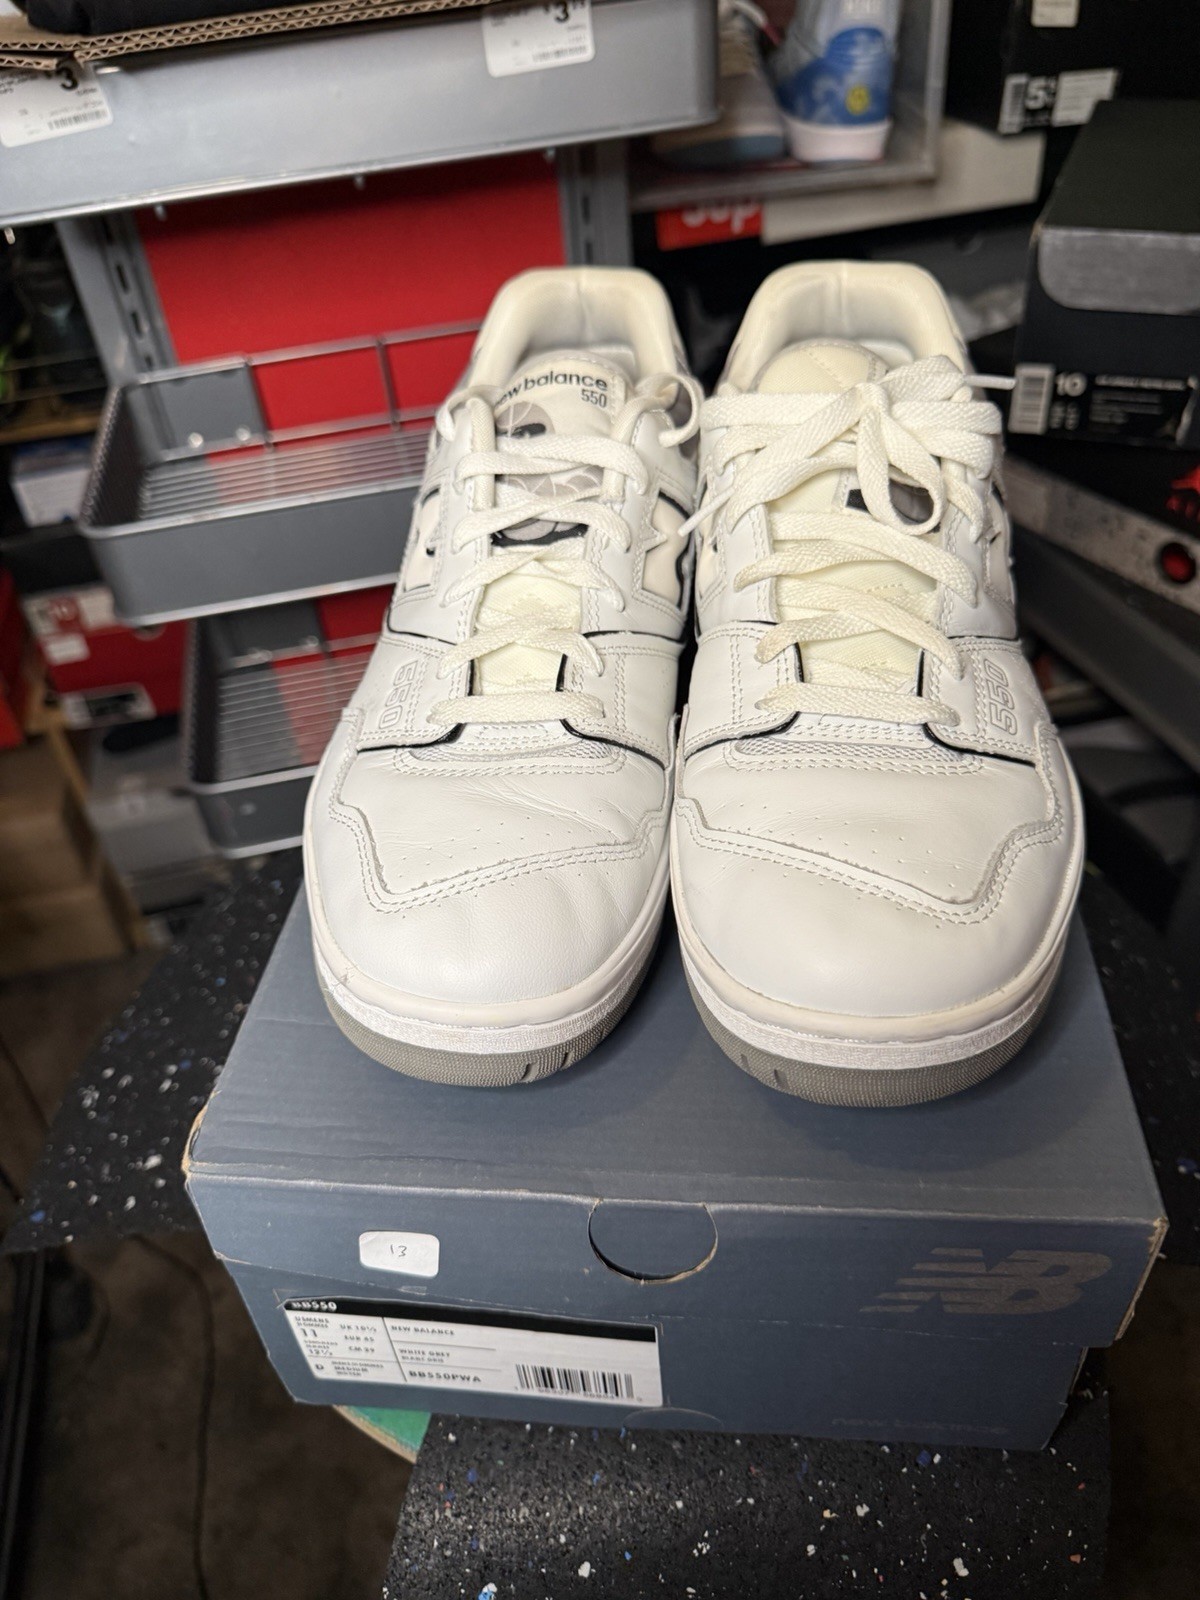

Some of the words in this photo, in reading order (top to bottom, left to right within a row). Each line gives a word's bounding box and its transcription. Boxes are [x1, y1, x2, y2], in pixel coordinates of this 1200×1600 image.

[524, 371, 608, 391] balance
[580, 389, 607, 408] 550
[379, 660, 418, 730] 550
[982, 659, 1018, 736] 550
[390, 1244, 407, 1258] 13
[290, 1301, 338, 1313] BB550
[300, 1328, 318, 1338] 11
[413, 1327, 455, 1336] BALANCE
[408, 1370, 482, 1383] BB550PWA
